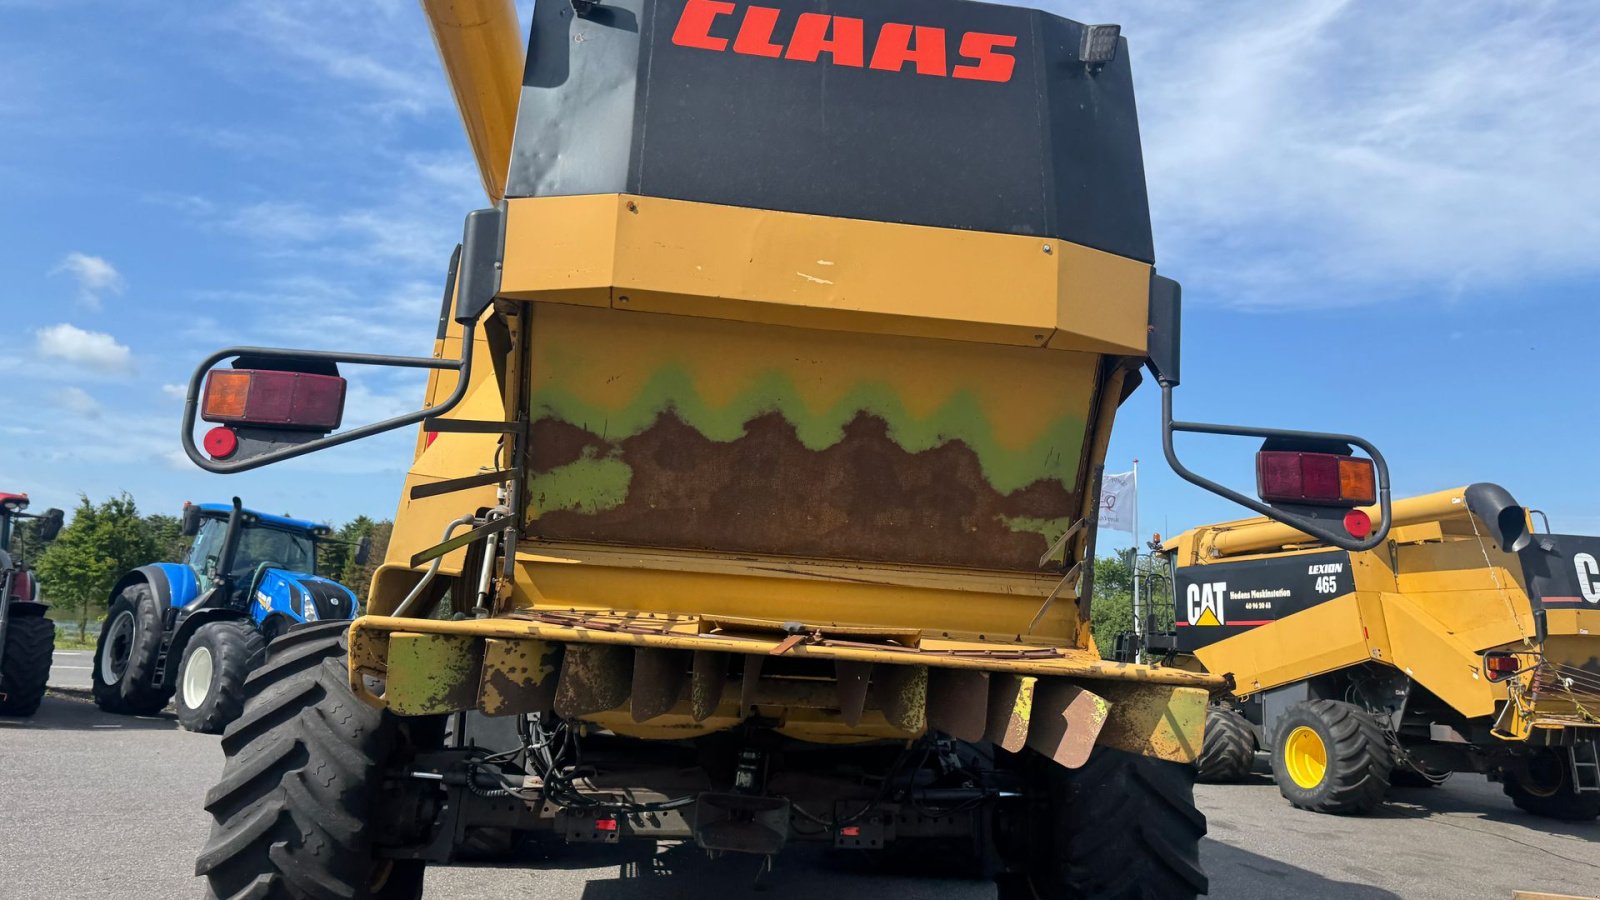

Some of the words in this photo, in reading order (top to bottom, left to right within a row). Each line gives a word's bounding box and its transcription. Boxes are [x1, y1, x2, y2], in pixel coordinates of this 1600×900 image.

[672, 0, 1017, 82] CLAAS
[1308, 563, 1343, 575] LEXION
[1250, 588, 1291, 599] Maskinstation
[1315, 576, 1337, 594] 465
[1187, 582, 1227, 626] CAT
